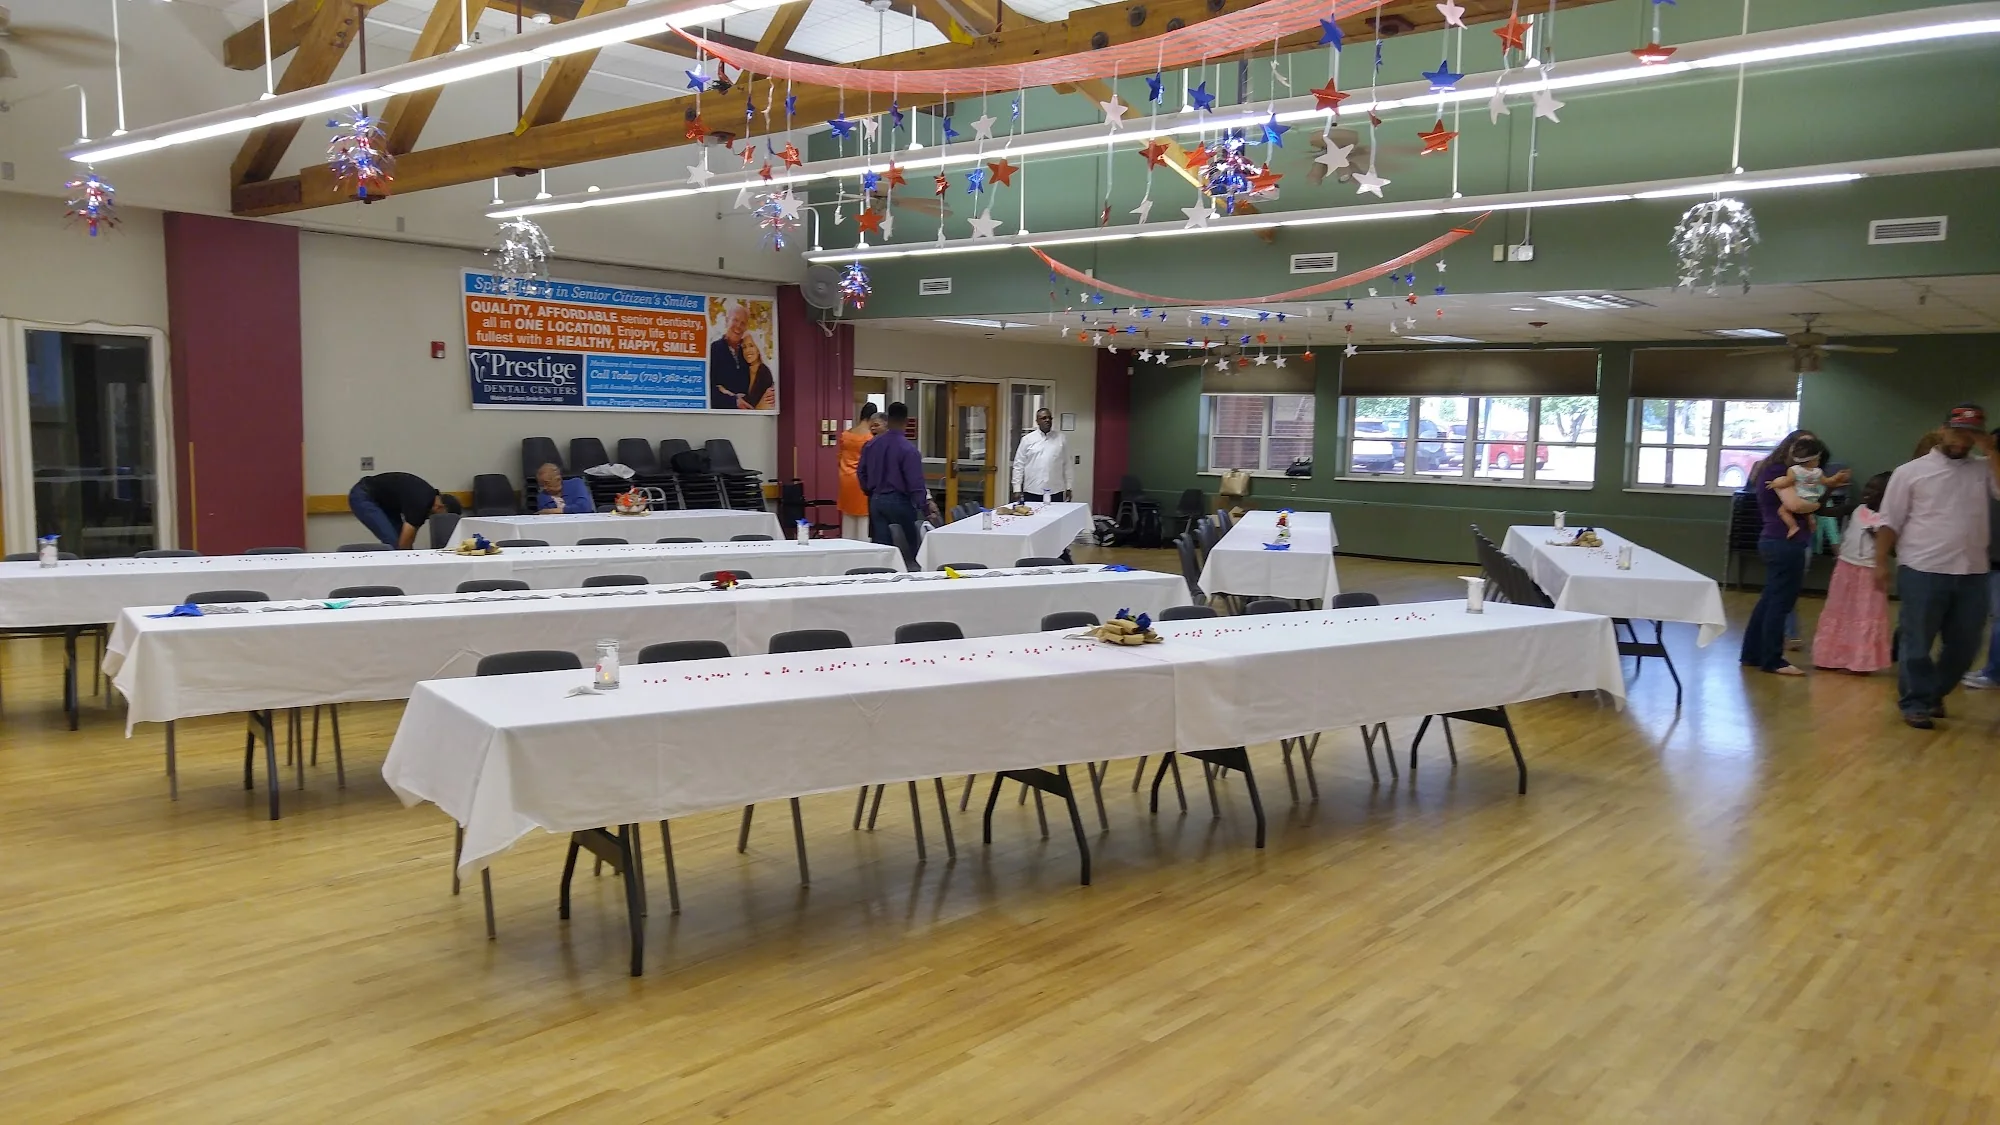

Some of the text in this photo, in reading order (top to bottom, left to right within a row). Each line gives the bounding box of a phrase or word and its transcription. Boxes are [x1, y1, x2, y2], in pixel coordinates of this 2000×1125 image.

[556, 286, 569, 298] in
[571, 287, 612, 300] Senior
[612, 290, 661, 306] Citizen's
[663, 295, 699, 309] Smiles
[470, 301, 704, 331] QUALITY, AFFORDABLE senior dentistry,
[482, 317, 695, 341] all in ONE LOCATION. Enjoy life to it's
[476, 330, 514, 343] fullest
[517, 333, 542, 344] with
[556, 336, 615, 350] HEALTHY,
[618, 339, 660, 353] HAPPY,
[662, 342, 699, 354] SMILE.
[490, 353, 577, 386] Prestige
[590, 370, 609, 380] Call
[611, 371, 638, 383] Today
[483, 384, 578, 395] DENTAL CENTERS
